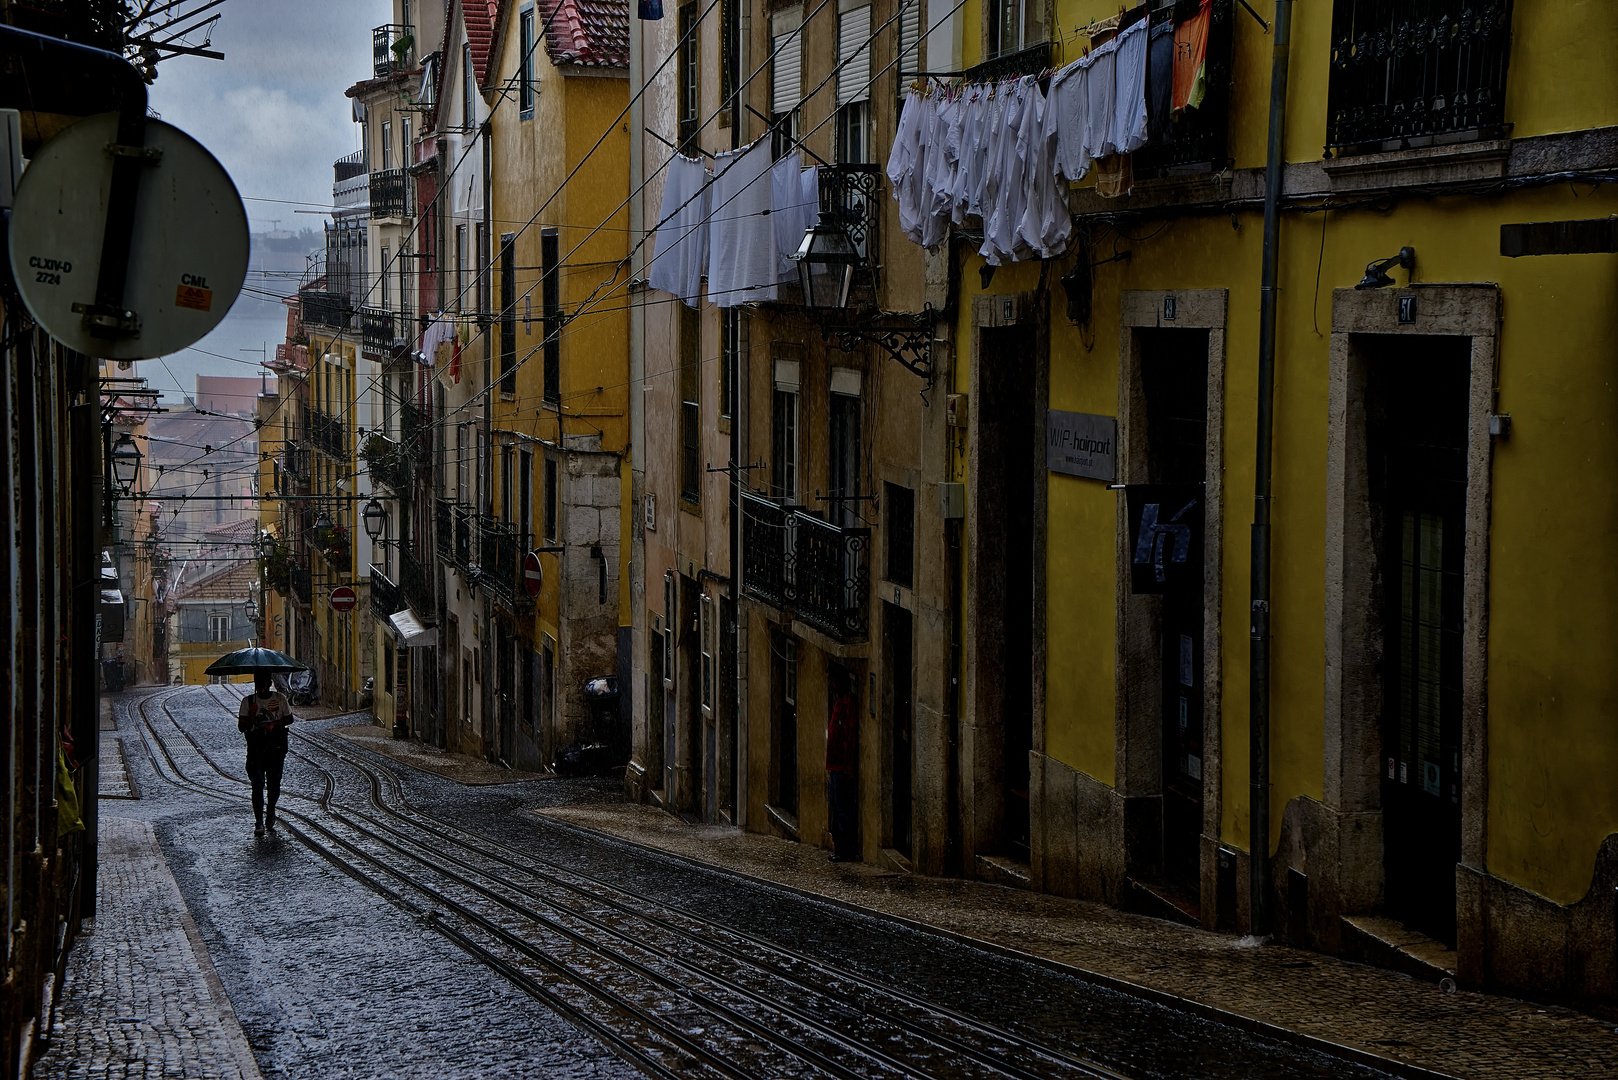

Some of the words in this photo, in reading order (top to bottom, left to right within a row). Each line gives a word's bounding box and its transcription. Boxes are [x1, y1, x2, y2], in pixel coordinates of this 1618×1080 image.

[29, 256, 72, 273] CLXIV-D
[36, 271, 61, 285] 2724
[181, 273, 209, 289] CML
[1400, 298, 1412, 321] 51
